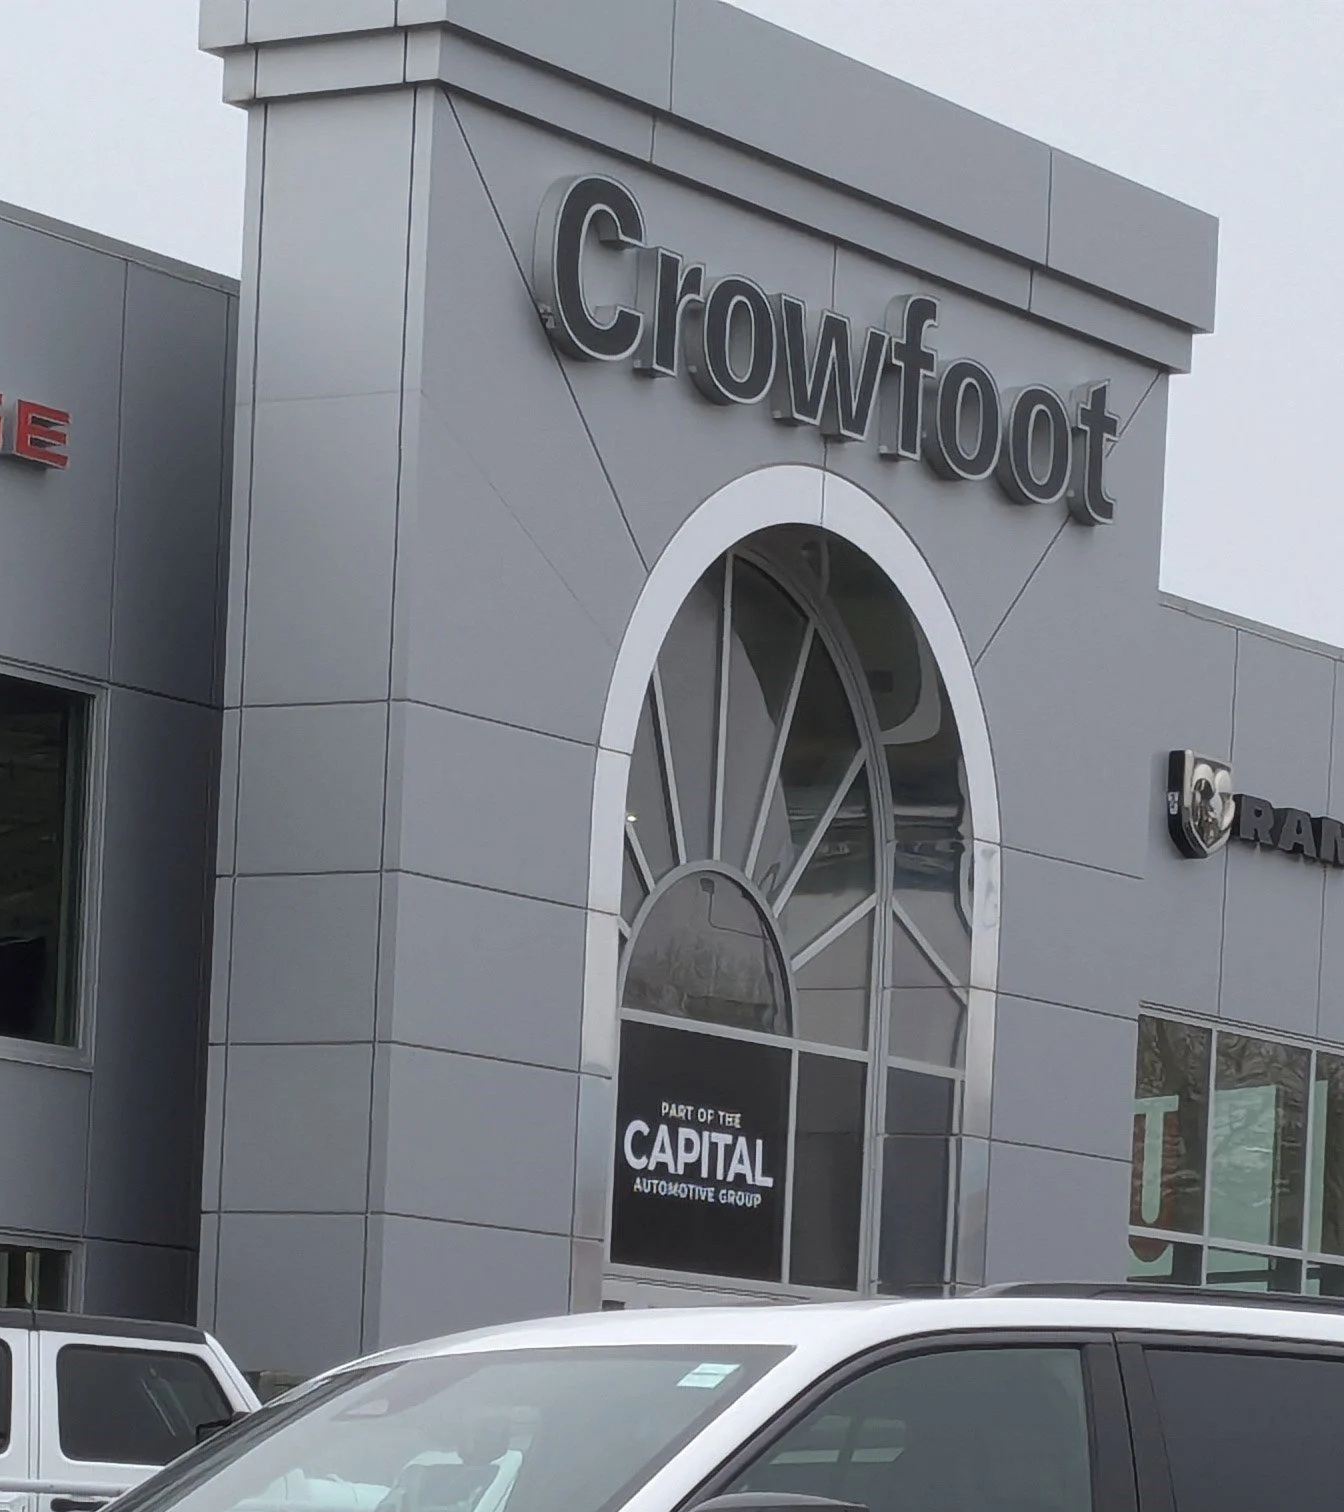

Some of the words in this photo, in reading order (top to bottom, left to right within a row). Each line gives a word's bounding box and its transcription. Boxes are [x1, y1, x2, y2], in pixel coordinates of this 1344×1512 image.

[538, 173, 1119, 525] Crowfoot
[660, 1101, 694, 1122] PART
[697, 1107, 715, 1124] OF
[717, 1110, 742, 1129] THE
[623, 1119, 774, 1188] CAPITAL
[633, 1176, 715, 1203] AUTOMOTIVE
[718, 1189, 762, 1208] GROUP
